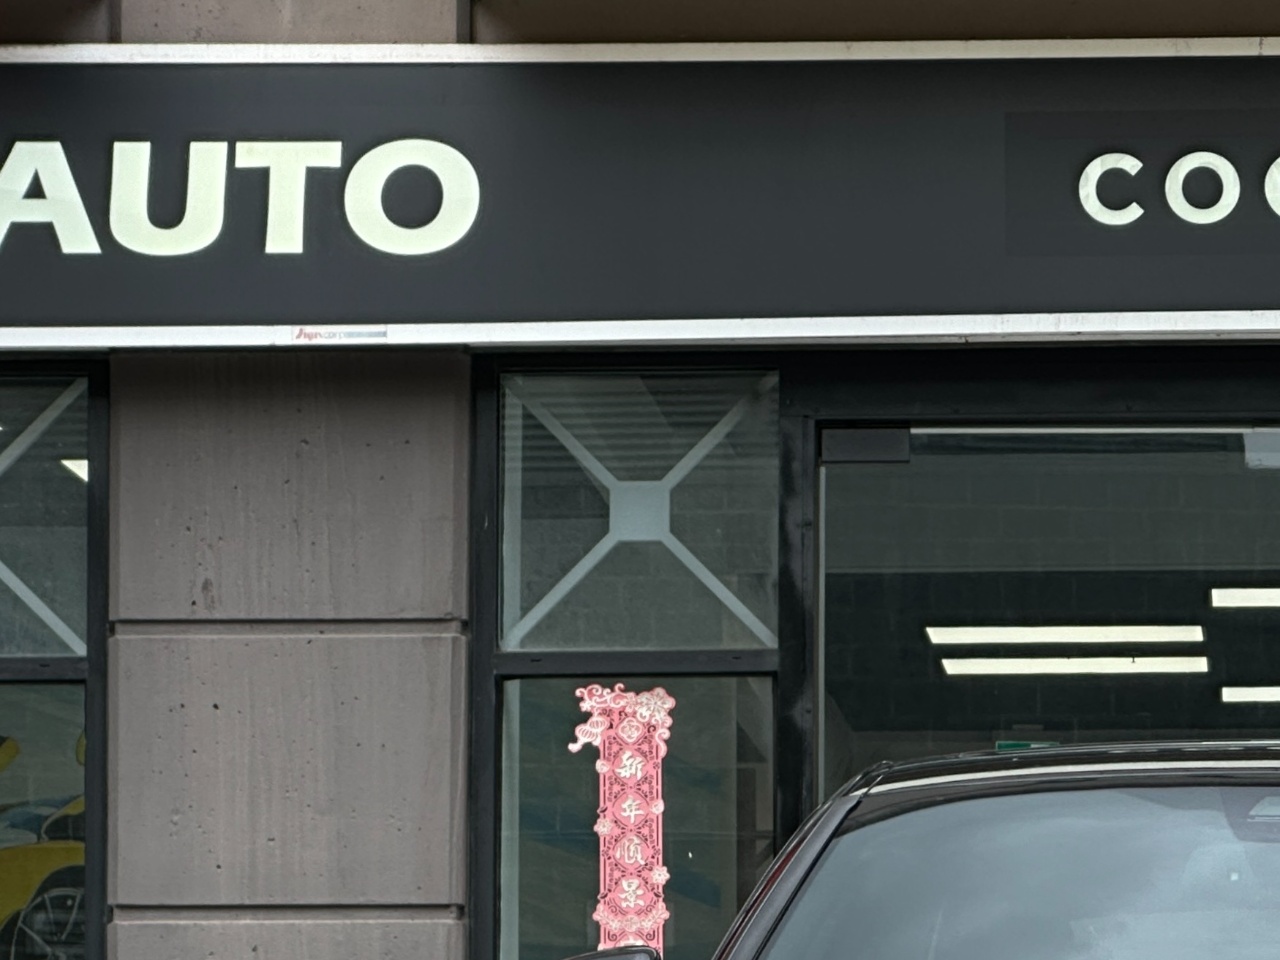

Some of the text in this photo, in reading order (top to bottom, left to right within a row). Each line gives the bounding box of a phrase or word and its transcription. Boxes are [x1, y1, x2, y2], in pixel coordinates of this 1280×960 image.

[0, 139, 481, 256] AUTO
[614, 751, 646, 947] 新年顺景
